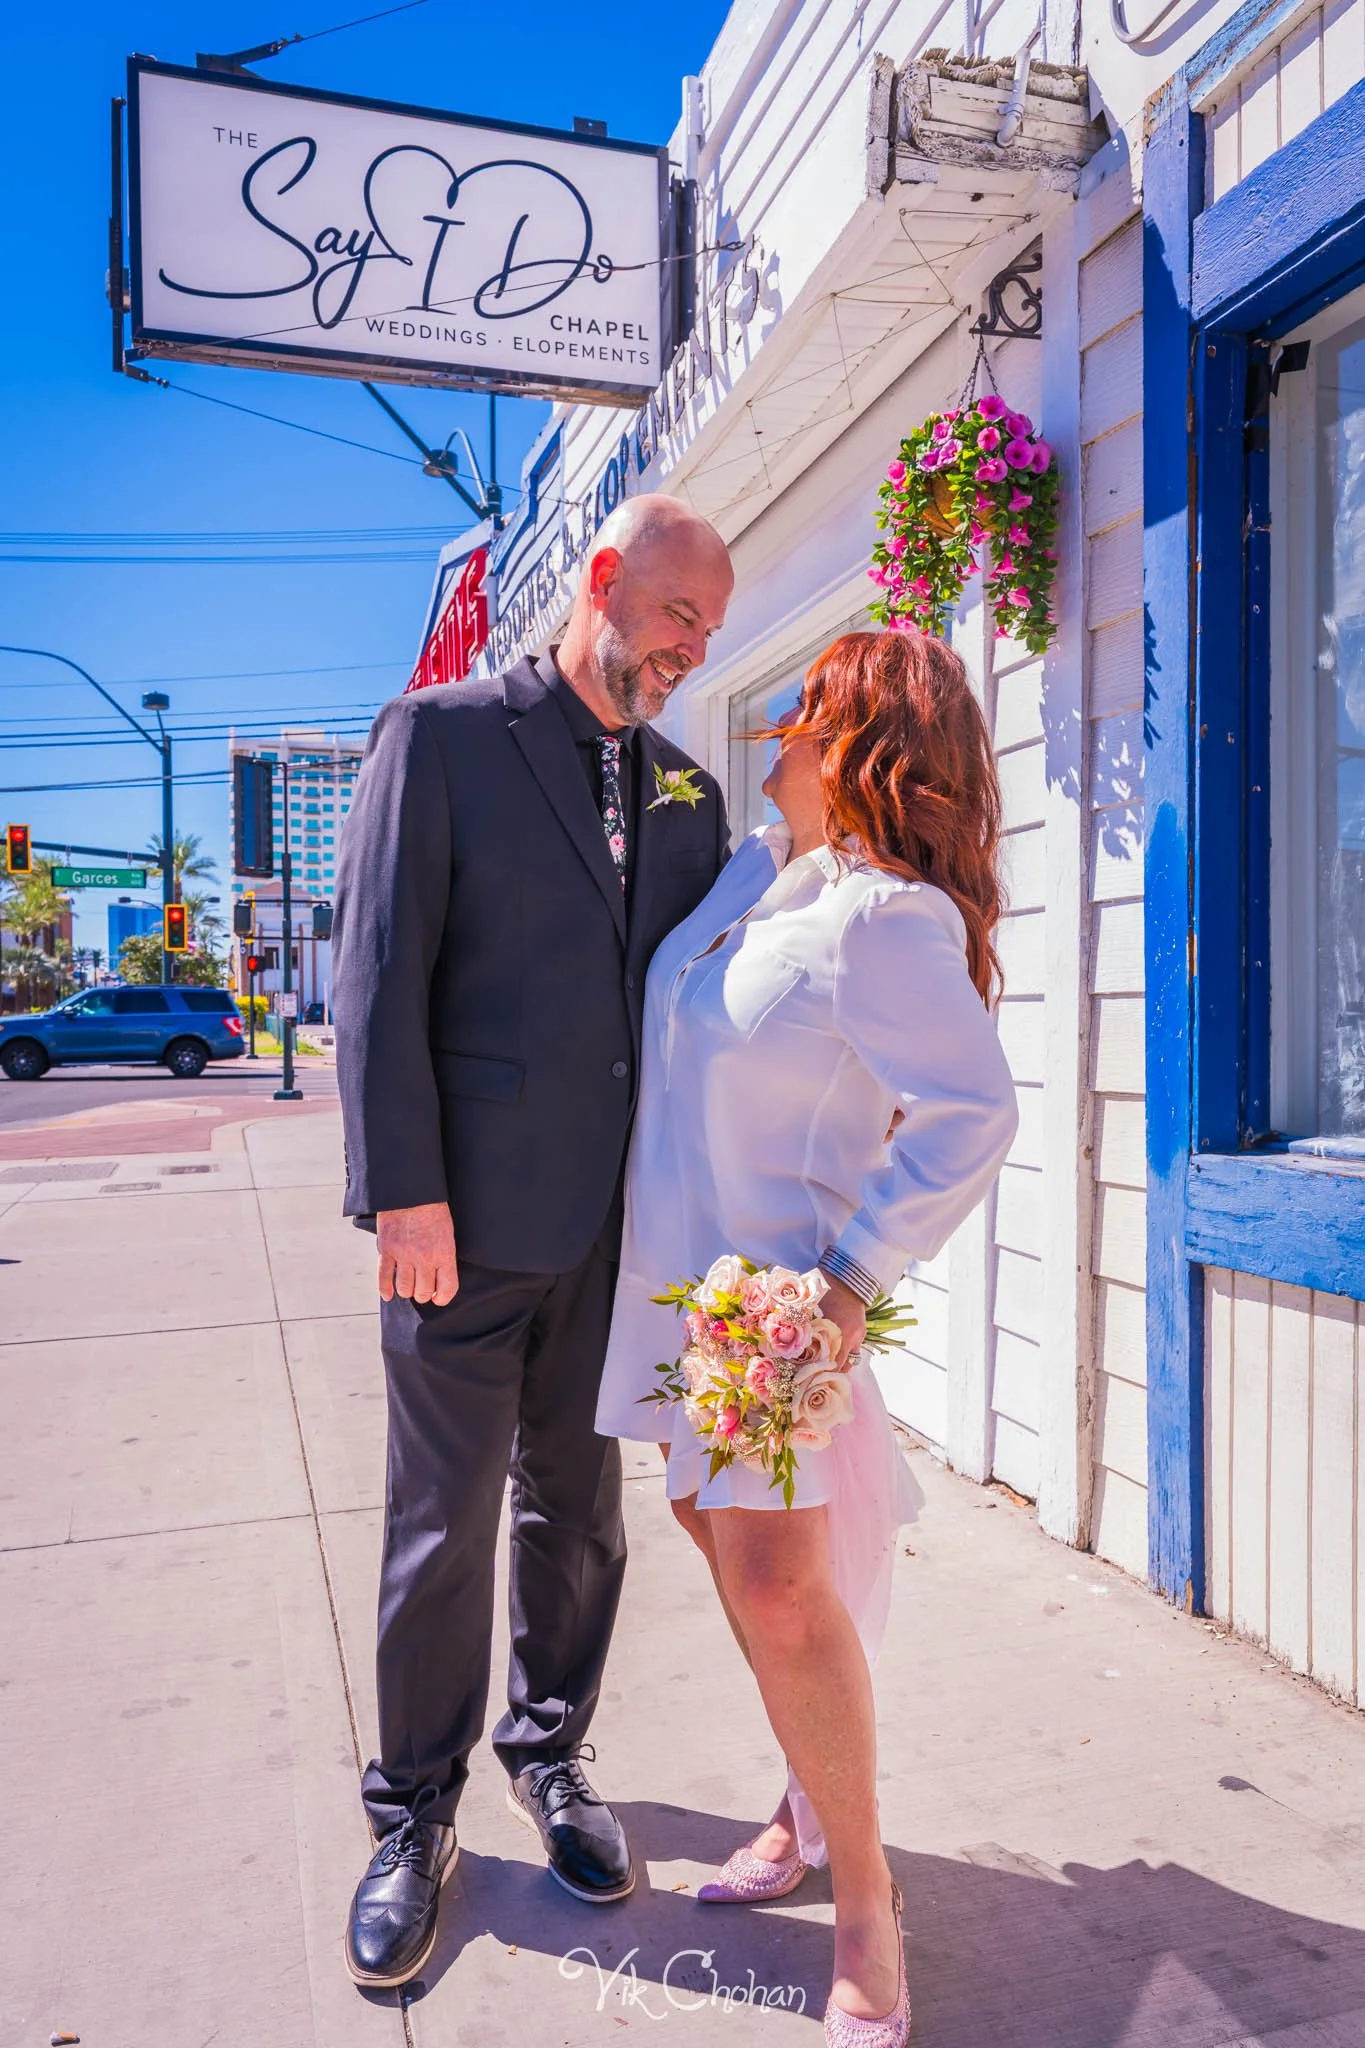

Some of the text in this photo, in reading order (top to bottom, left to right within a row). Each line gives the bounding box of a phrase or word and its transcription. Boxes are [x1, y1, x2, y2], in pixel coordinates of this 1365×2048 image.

[212, 126, 259, 149] THE
[159, 136, 642, 329] Say I Do
[366, 317, 651, 366] WEDDINGS ELOPEMENTS
[550, 314, 650, 343] CHAPEL
[484, 234, 759, 678] WEDDINGS & ELOPEMENTS
[72, 871, 118, 885] Garces
